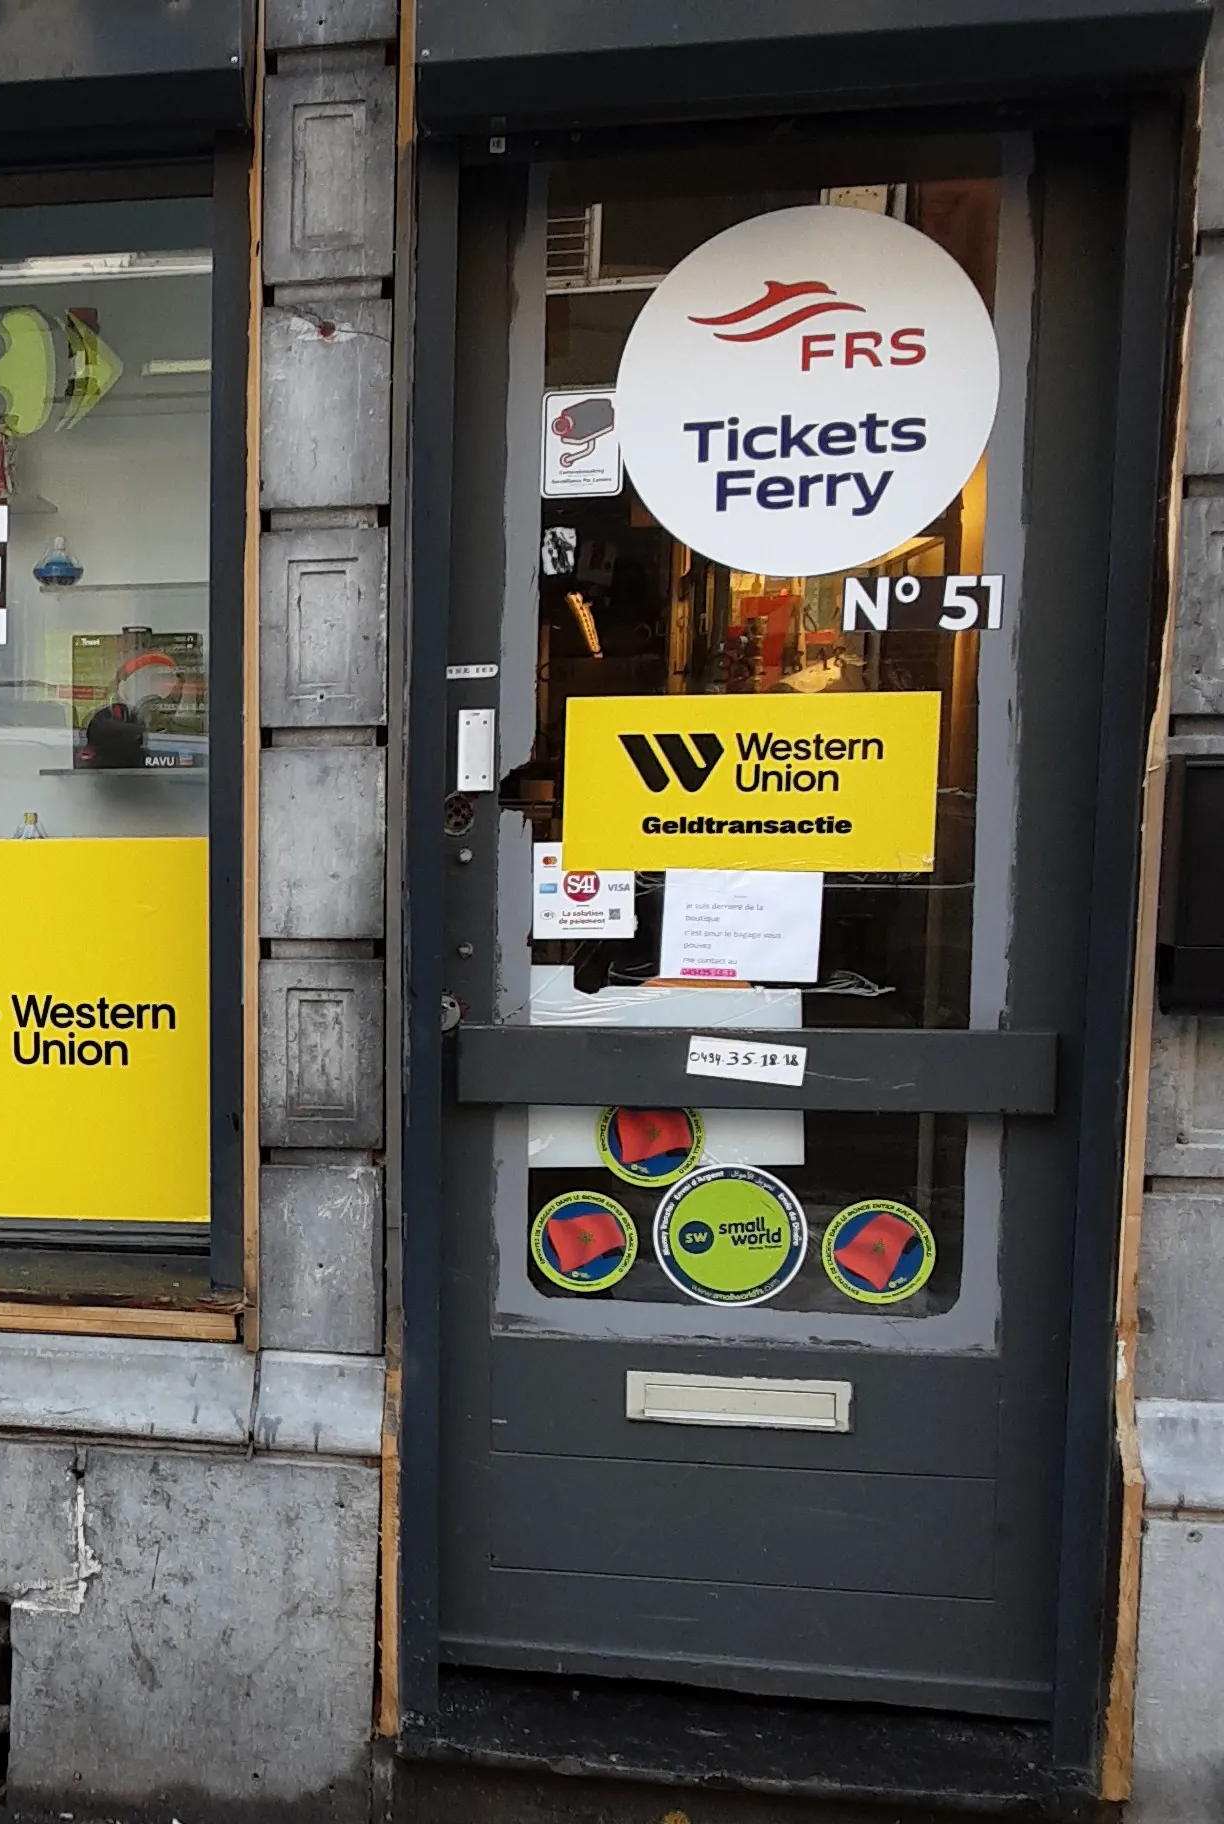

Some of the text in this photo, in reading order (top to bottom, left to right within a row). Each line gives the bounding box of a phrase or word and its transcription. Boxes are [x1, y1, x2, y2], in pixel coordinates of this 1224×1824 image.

[801, 328, 926, 372] FRS
[683, 413, 926, 463] Tickets
[716, 470, 894, 516] Ferry
[939, 574, 1004, 631] 51
[145, 756, 175, 766] RAVU
[735, 732, 884, 762] Western
[735, 763, 839, 793] Union
[642, 816, 853, 835] Geldtransactie
[608, 883, 631, 892] VISA
[569, 918, 605, 926] paiement
[11, 994, 177, 1030] Western
[12, 1031, 129, 1066] Union
[718, 1216, 765, 1235] small
[730, 1227, 782, 1247] world
